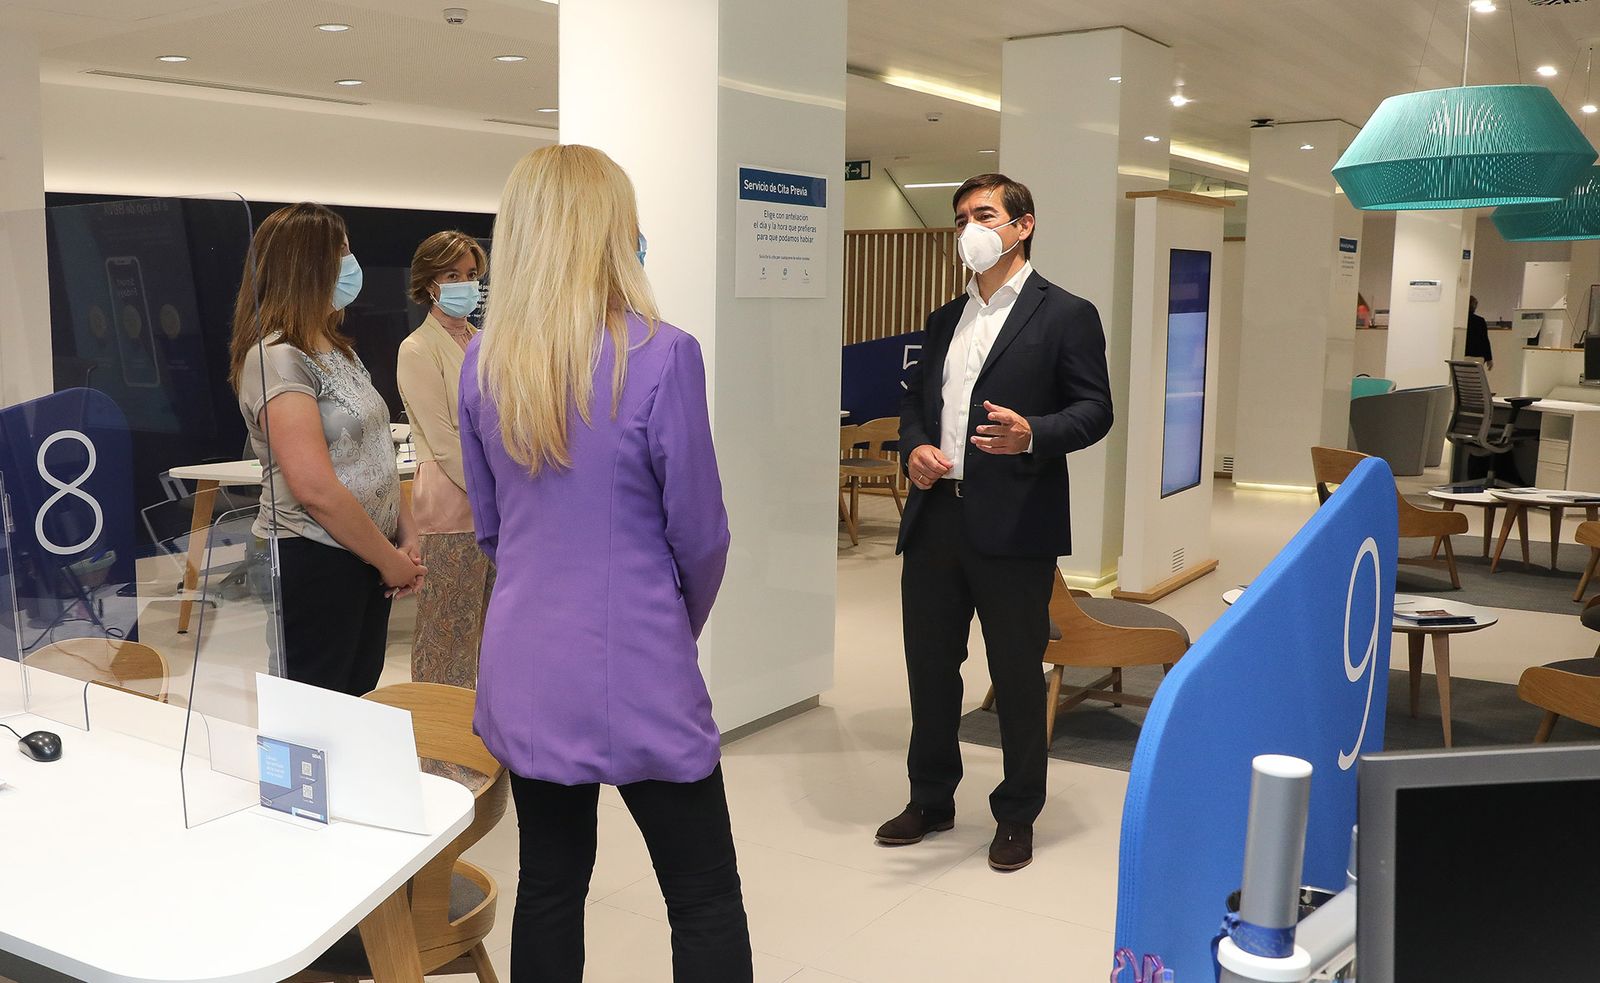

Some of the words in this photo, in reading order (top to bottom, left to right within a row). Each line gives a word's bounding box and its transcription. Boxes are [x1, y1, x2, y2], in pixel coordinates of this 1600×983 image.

[743, 179, 768, 192] Servicio
[769, 183, 776, 193] de
[777, 184, 790, 195] Cita
[790, 185, 808, 197] Previa
[763, 209, 776, 220] Elige
[753, 221, 758, 229] el
[771, 222, 777, 230] la
[777, 222, 788, 231] hora
[756, 233, 768, 242] para
[768, 234, 778, 242] que
[779, 234, 800, 243] podamos
[800, 235, 814, 244] hablar
[34, 429, 104, 555] 8
[1337, 536, 1381, 771] 9
